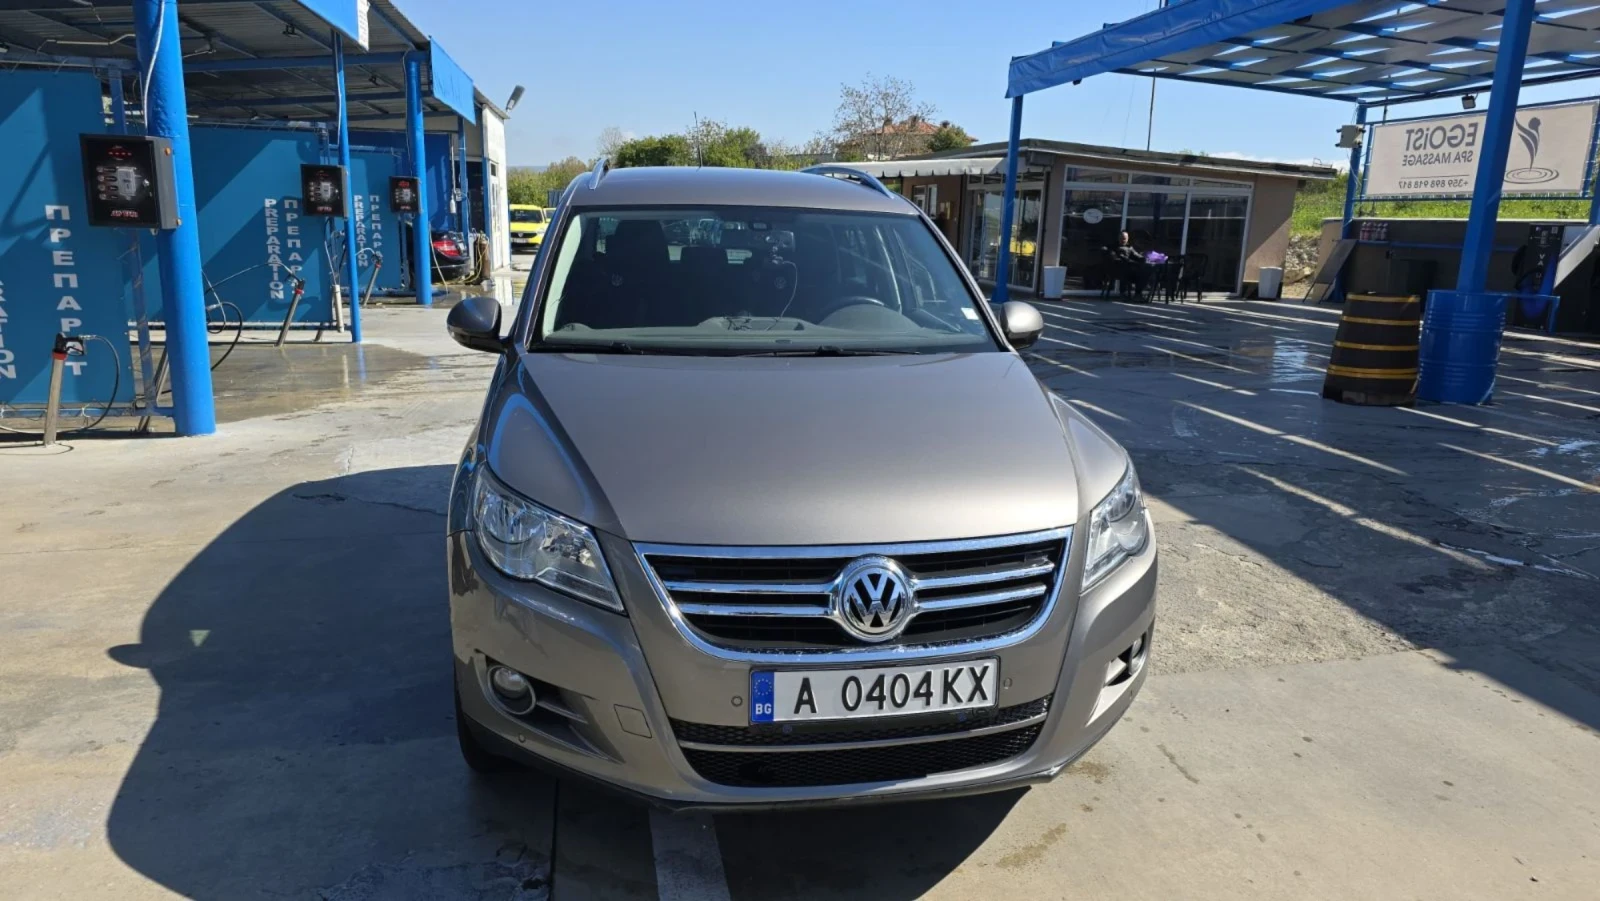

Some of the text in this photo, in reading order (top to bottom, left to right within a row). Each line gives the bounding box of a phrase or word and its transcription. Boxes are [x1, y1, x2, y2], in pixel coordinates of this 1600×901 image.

[264, 198, 285, 300] PREPARATION
[284, 199, 304, 298] ПРЕПАР
[354, 195, 369, 267] PREPARATION
[755, 703, 772, 715] BG
[793, 677, 817, 714] A
